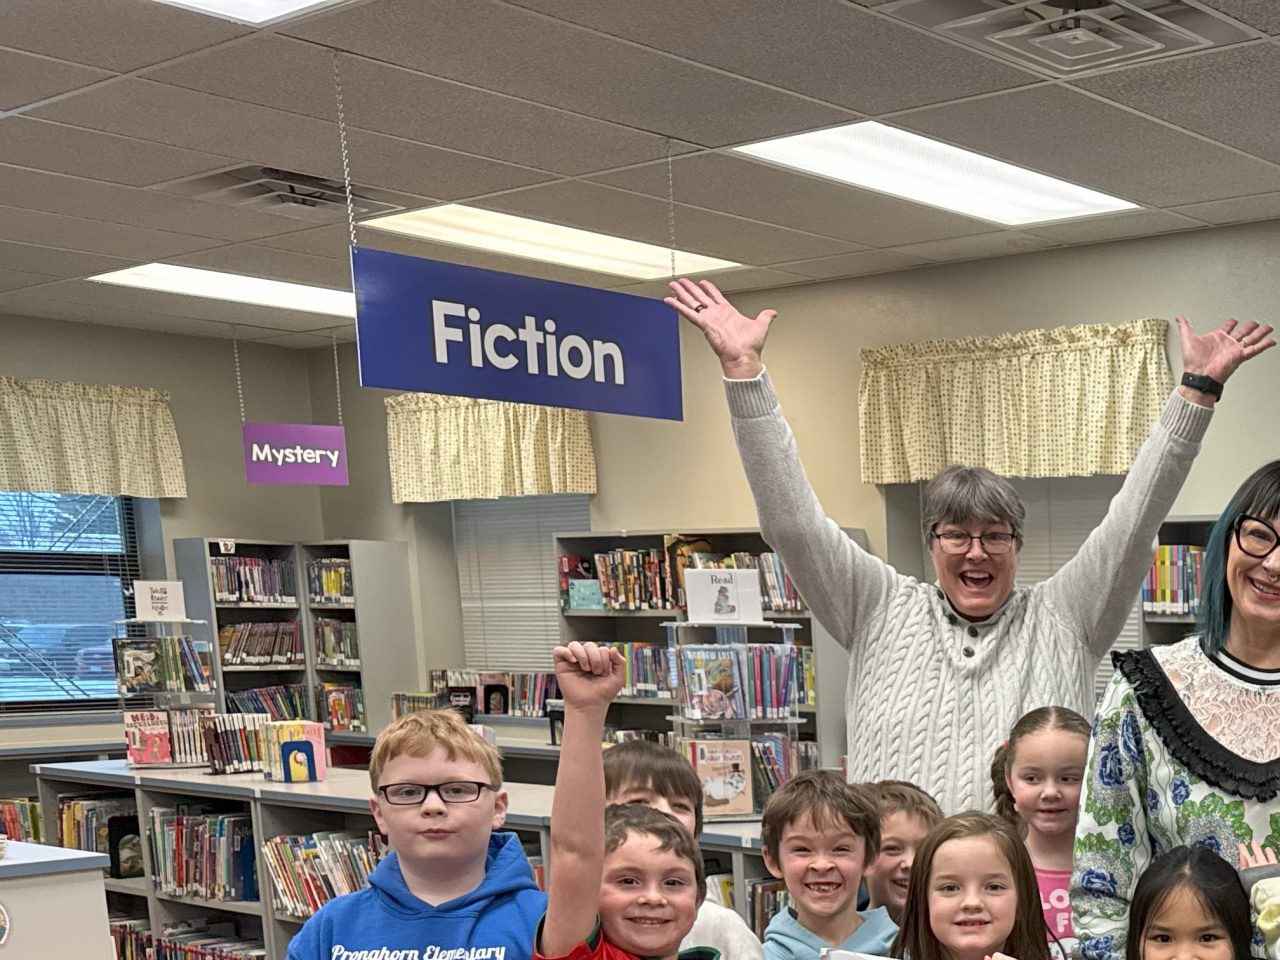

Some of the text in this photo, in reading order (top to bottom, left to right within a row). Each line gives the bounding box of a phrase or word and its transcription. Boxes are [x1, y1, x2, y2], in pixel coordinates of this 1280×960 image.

[432, 299, 625, 386] Fiction
[251, 443, 339, 468] Mystery
[710, 573, 734, 584] Read
